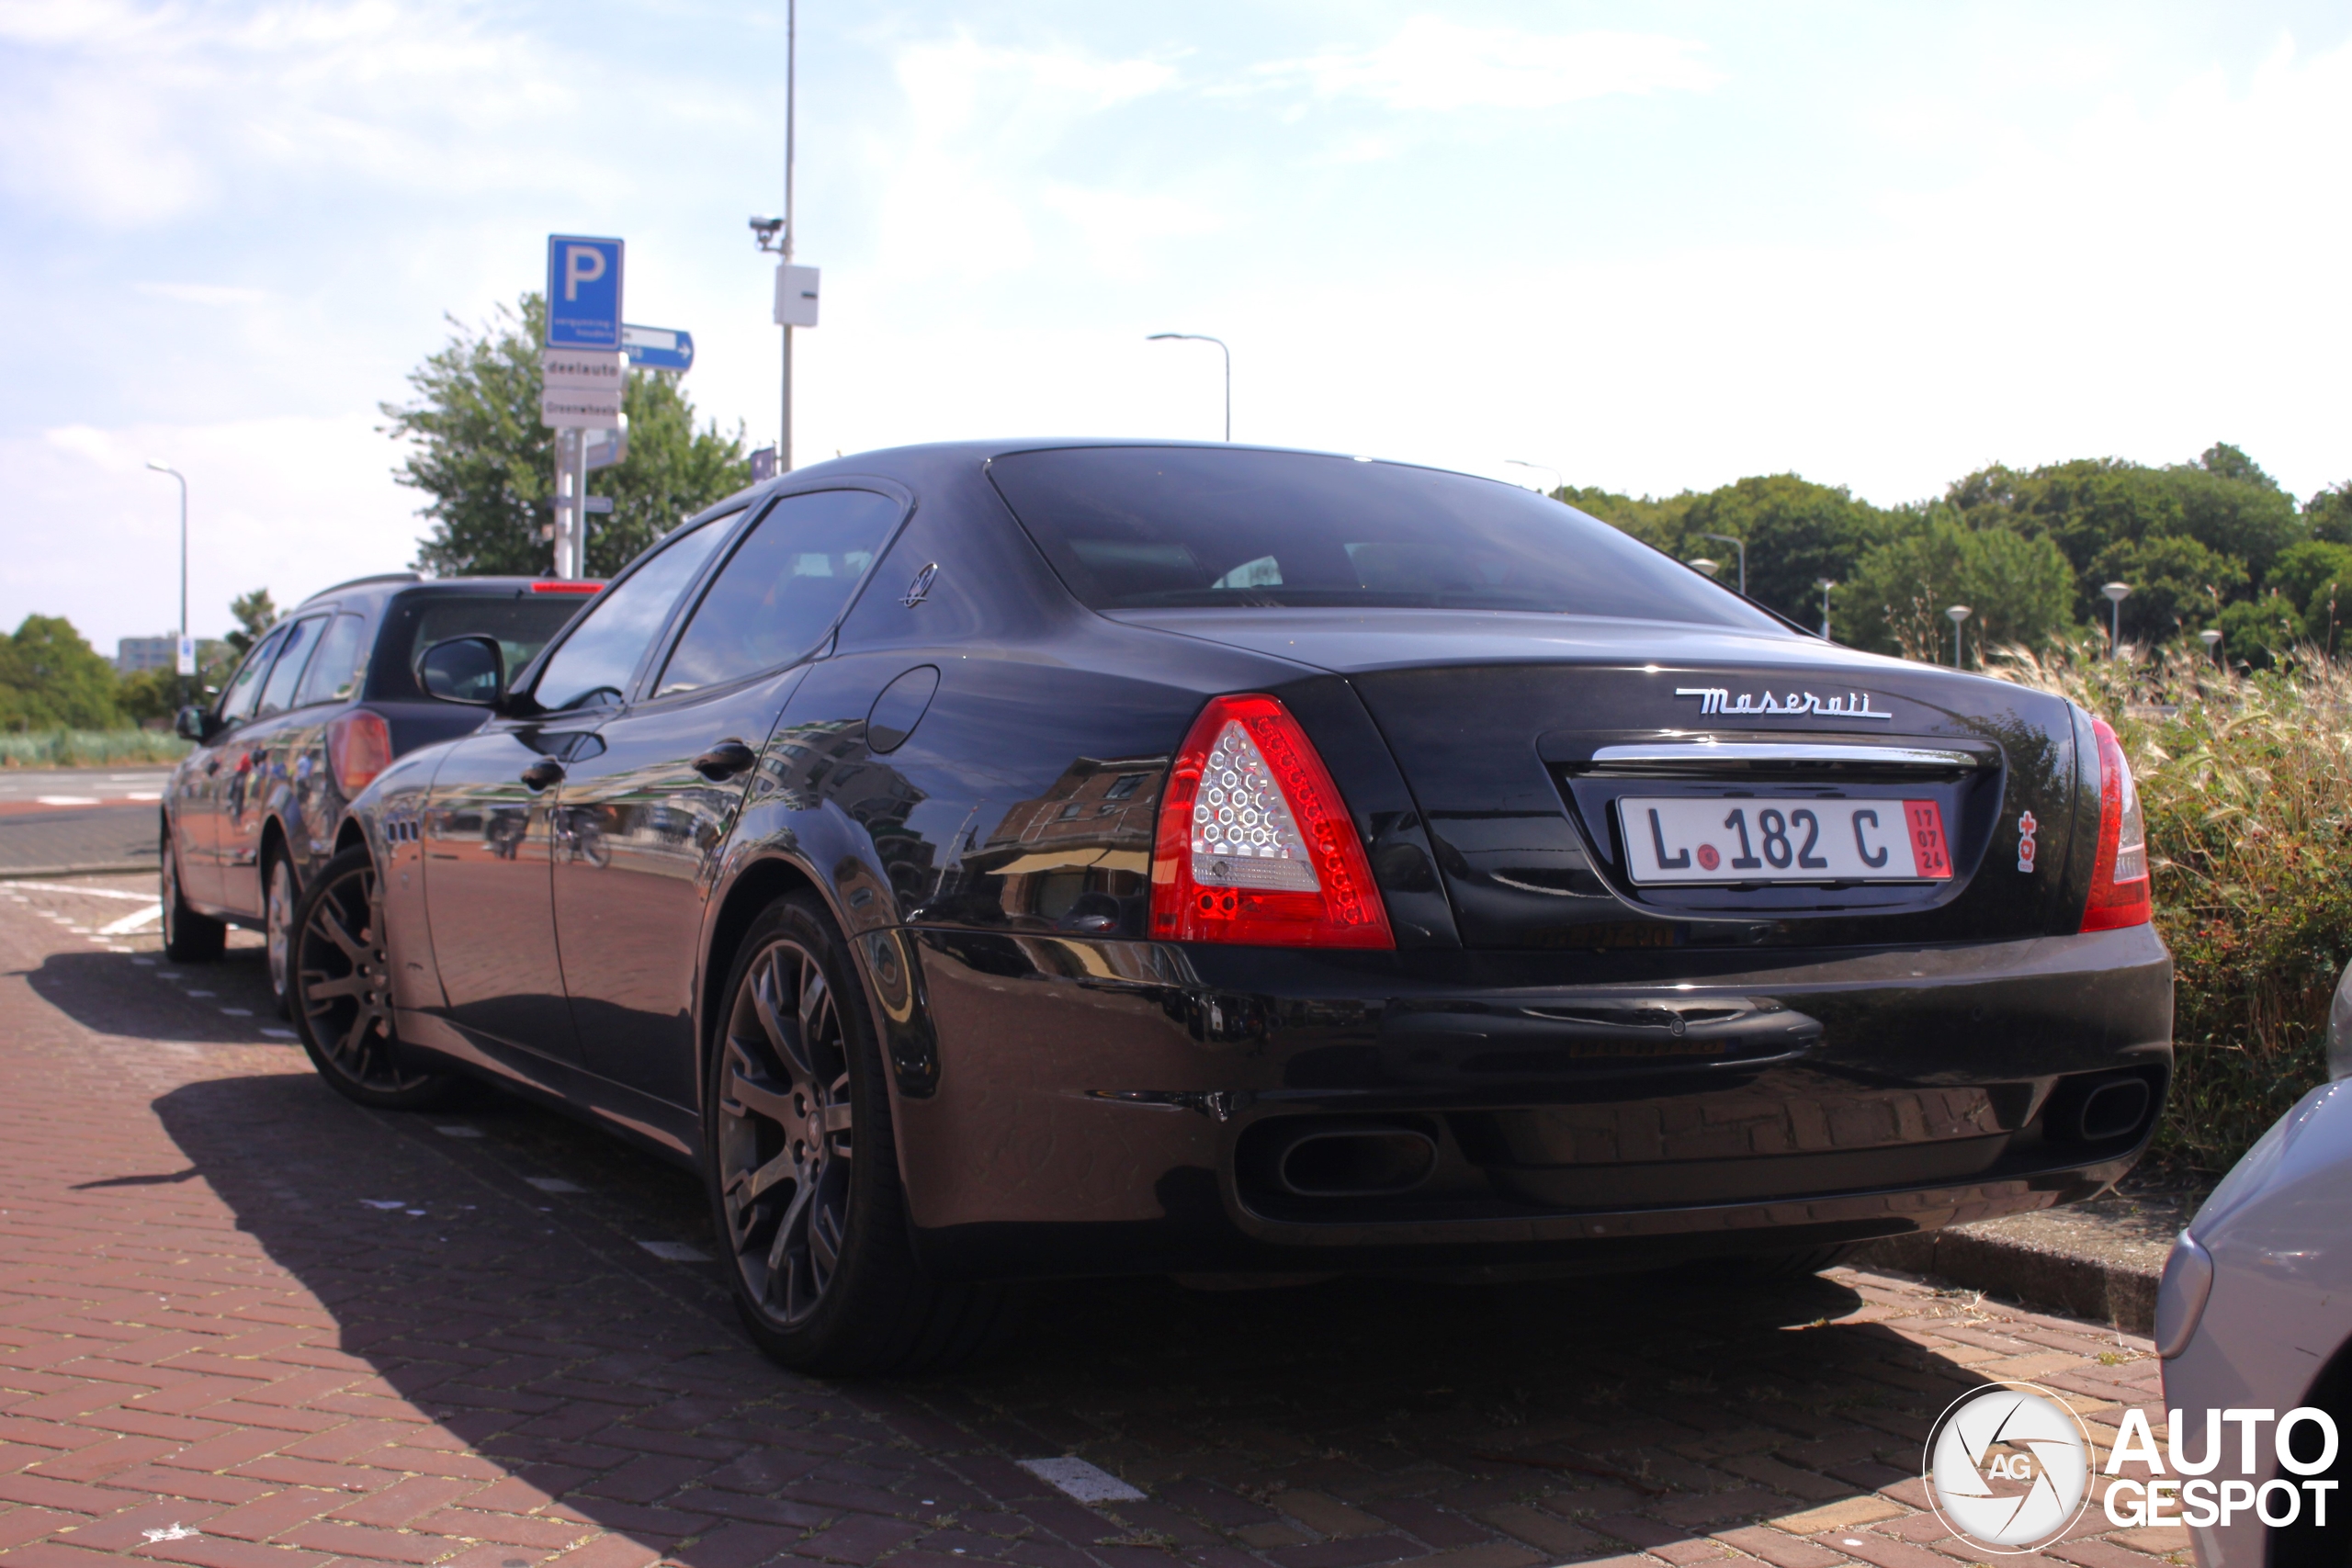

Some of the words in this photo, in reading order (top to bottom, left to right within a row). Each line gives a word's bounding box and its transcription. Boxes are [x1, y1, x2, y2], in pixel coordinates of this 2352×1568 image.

[565, 245, 606, 301] P
[548, 360, 617, 377] deelauto
[1675, 688, 1893, 719] Maserati
[1914, 809, 1932, 827] 17
[1646, 808, 1690, 870] L
[1724, 808, 1827, 869] 182
[1851, 809, 1888, 868] C
[1917, 829, 1937, 847] 07
[1922, 852, 1943, 869] 24
